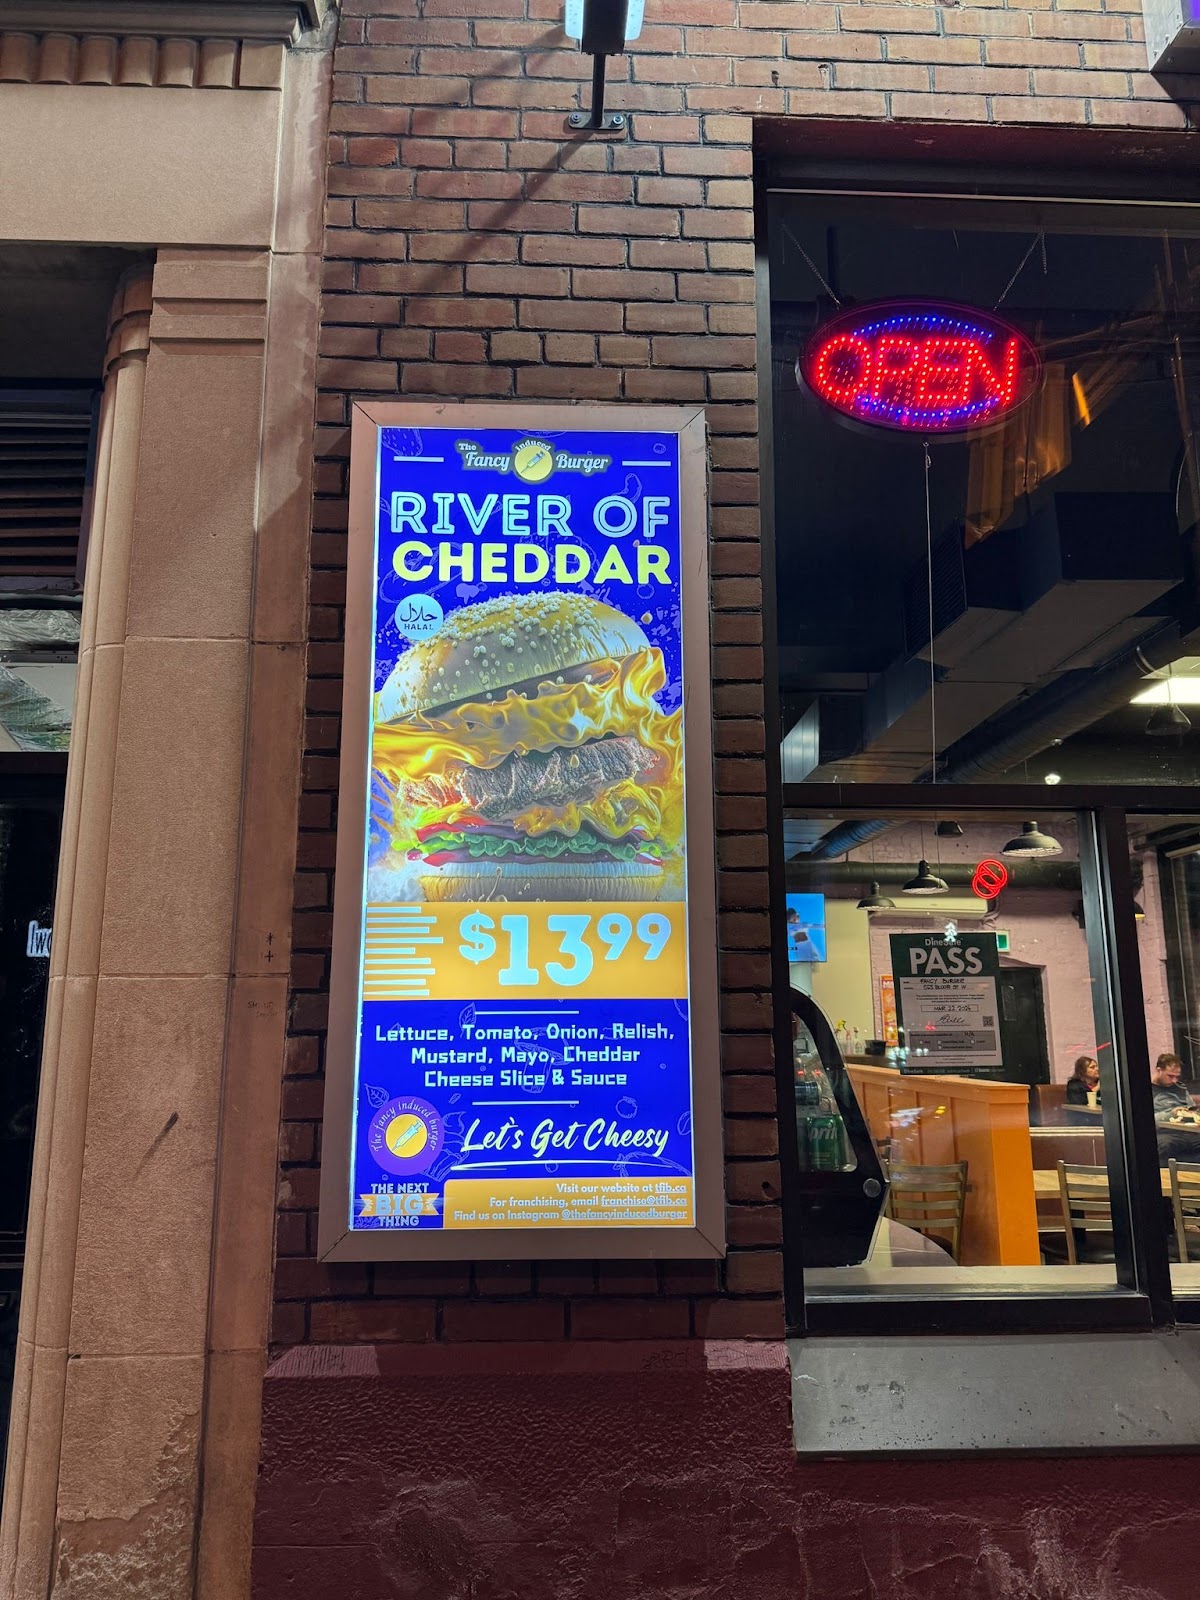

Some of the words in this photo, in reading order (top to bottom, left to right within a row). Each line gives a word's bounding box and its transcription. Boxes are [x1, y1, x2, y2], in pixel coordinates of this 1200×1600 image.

[816, 336, 1018, 402] OPEN
[459, 443, 477, 451] The
[515, 440, 551, 452] induced
[465, 452, 510, 472] Fancy
[556, 454, 609, 473] Burger
[390, 491, 573, 537] RIVER
[592, 495, 671, 538] OF
[392, 540, 672, 585] CHEDDAR
[404, 623, 434, 631] HALAL
[909, 946, 983, 975] PASS
[375, 1025, 454, 1042] Lettuce,
[462, 1024, 539, 1041] Tomato,
[546, 1023, 605, 1040] Onion,
[612, 1023, 676, 1040] Relish,
[411, 1047, 494, 1064] Mustard,
[501, 1047, 556, 1066] Mayo,
[563, 1046, 641, 1062] Cheddar
[424, 1071, 494, 1087] Cheese
[500, 1069, 546, 1086] Slice
[552, 1069, 565, 1085] &
[571, 1069, 628, 1085] Sauce
[397, 1098, 436, 1119] induced
[373, 1106, 398, 1133] fancy
[371, 1132, 383, 1152] The
[427, 1118, 441, 1151] burger
[460, 1116, 524, 1153] Let's
[530, 1118, 587, 1158] Get
[583, 1117, 670, 1158] Cheesy
[370, 1183, 394, 1194] THE
[397, 1182, 430, 1194] NEXT
[556, 1183, 579, 1193] Visit
[581, 1185, 599, 1193] our
[600, 1182, 640, 1193] website
[642, 1183, 653, 1193] at
[654, 1182, 687, 1194] tfib.ca
[376, 1194, 424, 1215] BIG
[489, 1197, 506, 1207] For
[509, 1196, 569, 1208] franchising,
[571, 1196, 599, 1206] email
[601, 1195, 687, 1207] franchise@tfib.ca
[378, 1215, 420, 1227] THING
[454, 1210, 476, 1220] Find
[478, 1212, 490, 1220] us
[492, 1211, 505, 1220] on
[507, 1210, 559, 1222] Instagram
[561, 1208, 688, 1221] @thefancyinducedburger
